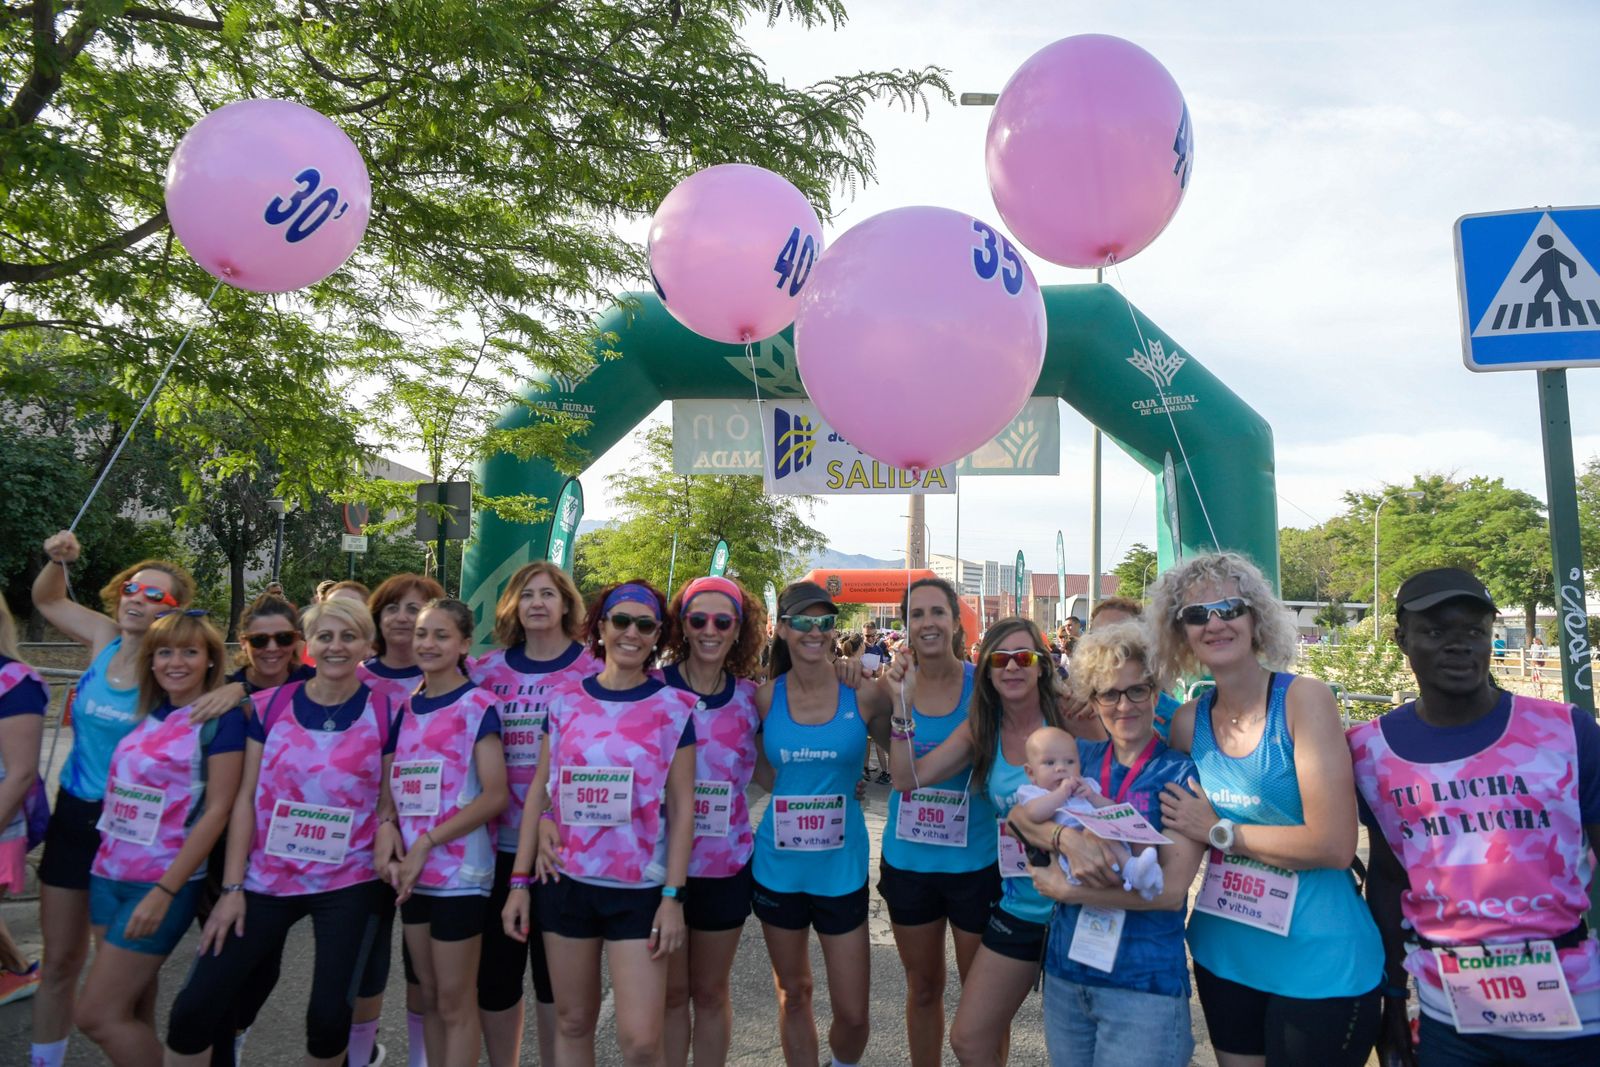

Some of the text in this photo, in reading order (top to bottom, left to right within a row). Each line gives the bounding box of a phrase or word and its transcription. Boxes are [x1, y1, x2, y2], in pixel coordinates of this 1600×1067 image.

[562, 402, 596, 413] RURAL
[1132, 395, 1199, 410] CAJA RURAL
[826, 460, 947, 490] SALIDA
[791, 748, 838, 760] olimpo
[572, 773, 630, 782] COVIRAN
[114, 786, 162, 803] COVIRAN
[577, 787, 609, 803] 5012
[1211, 789, 1261, 807] olimpo
[1390, 775, 1529, 807] TU LUCHA
[788, 800, 844, 810] COVIRAN
[911, 793, 966, 806] COVIRAN
[290, 808, 350, 823] COVIRAN
[585, 812, 612, 820] vithas
[796, 815, 825, 830] 1197
[918, 807, 944, 823] 850
[1399, 808, 1551, 839] S MI LUCHA
[294, 823, 326, 840] 7410
[922, 830, 949, 839] vithas
[804, 837, 830, 845] vithas
[299, 846, 326, 855] vithas
[1222, 870, 1265, 898] 5565
[1229, 901, 1262, 919] vithas
[1457, 893, 1554, 919] aecc
[1460, 951, 1552, 970] COVIRAN
[1477, 976, 1527, 1000] 1179
[1500, 1011, 1546, 1024] vithas
